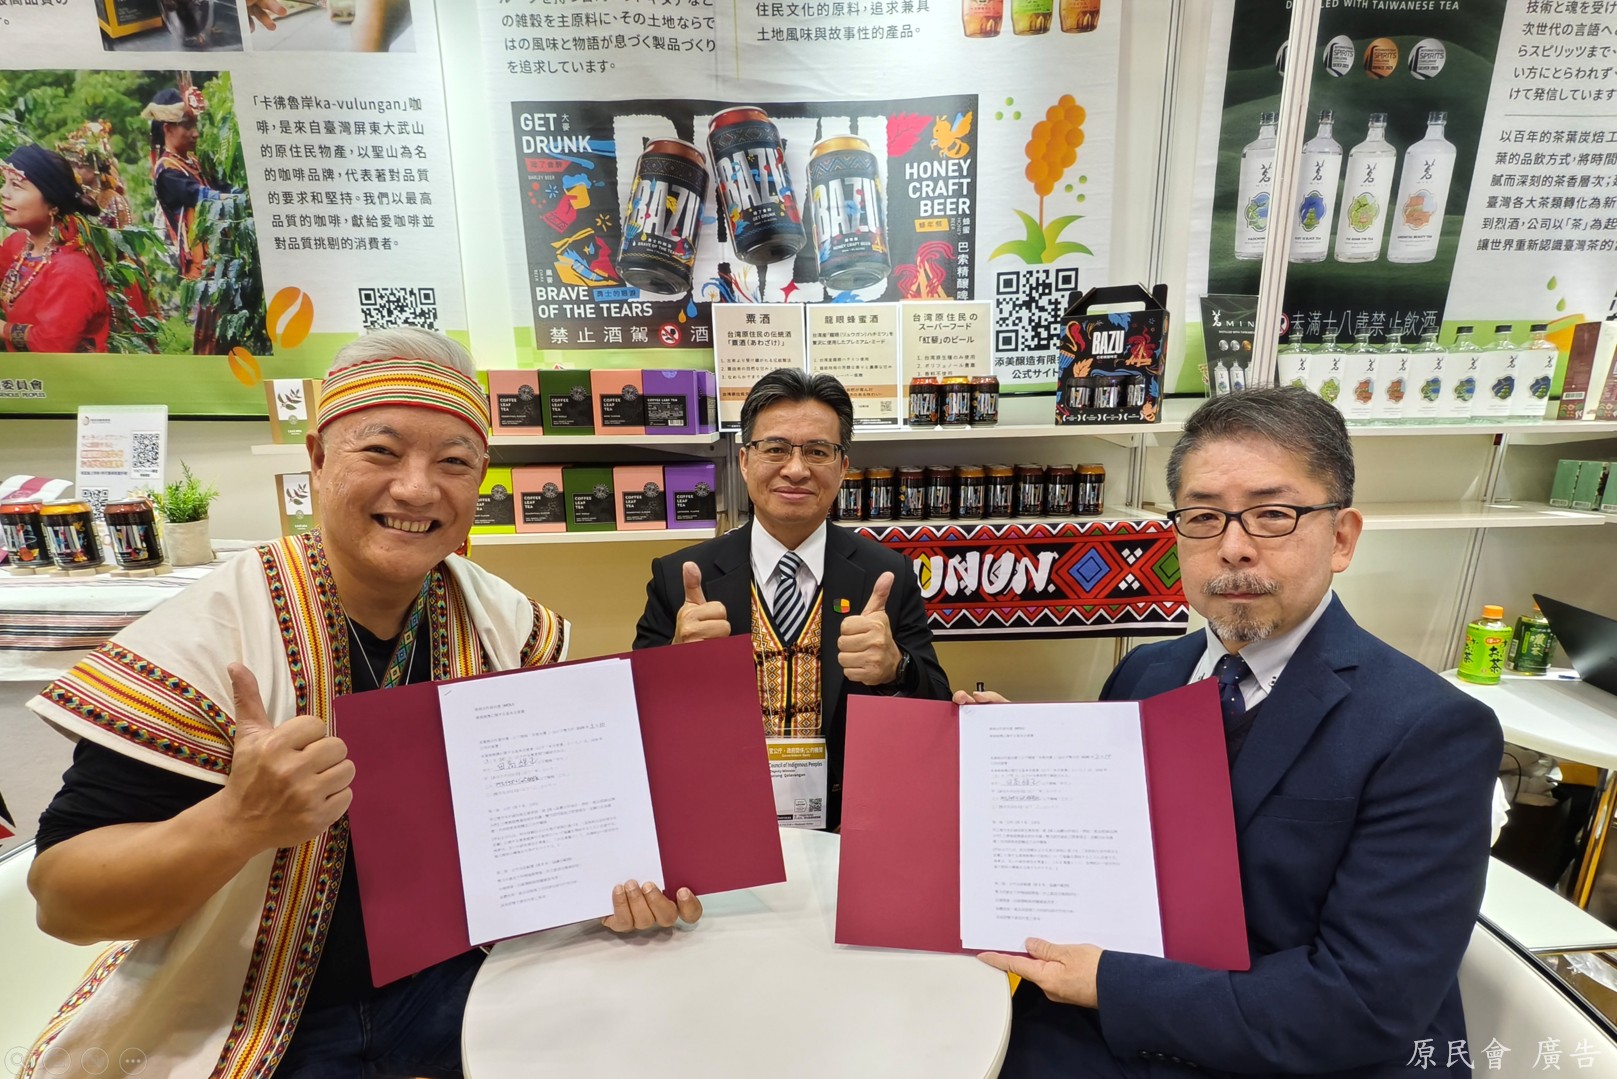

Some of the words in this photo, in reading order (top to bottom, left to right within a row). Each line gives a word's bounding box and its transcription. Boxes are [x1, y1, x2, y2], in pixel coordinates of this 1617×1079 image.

[1343, 0, 1369, 9] WITH
[1372, 2, 1434, 10] TAIWANESE
[1440, 2, 1460, 10] TEA
[757, 24, 920, 42] 土地風味與故事性的產品。
[1522, 22, 1617, 37] 次世代の言語へ
[1374, 52, 1396, 60] SPIRITS
[1419, 52, 1444, 60] SPIRITS
[507, 60, 615, 74] を追求しています。
[1509, 88, 1617, 102] けて発信しています
[256, 120, 424, 136] 啡，是來自臺灣屏東大武山
[520, 113, 557, 132] GET
[1499, 130, 1617, 144] 以百年的茶葉炭焙工
[260, 144, 427, 159] 的原住民物產，以聖山為名
[522, 135, 592, 154] DRUNK
[1495, 152, 1617, 166] 葉的品飲方式，將時間
[264, 168, 430, 182] 的咖啡品牌，代表著對品質
[905, 159, 972, 180] HONEY
[908, 179, 971, 198] CRAFT
[268, 191, 432, 206] 的要求和堅持。我們以最高
[1486, 196, 1617, 209] 臺灣各大茶類轉化為新
[812, 176, 880, 244] BAZU
[920, 198, 970, 217] BEER
[272, 214, 435, 228] 品質的咖啡，獻給愛咖啡並
[274, 236, 398, 250] 對品質挑剔的消費者。
[1476, 238, 1617, 252] 讓世界重新認識臺灣茶的
[535, 286, 590, 300] BRAVE
[538, 304, 559, 318] OF
[563, 304, 596, 318] THE
[600, 303, 653, 318] TEARS
[912, 312, 978, 322] 台湾原住民の
[918, 322, 972, 330] スーパーフード
[550, 326, 648, 344] 禁止酒駕
[690, 326, 708, 342] 酒
[1092, 330, 1124, 355] BAZU
[1012, 368, 1059, 379] 公式サイト
